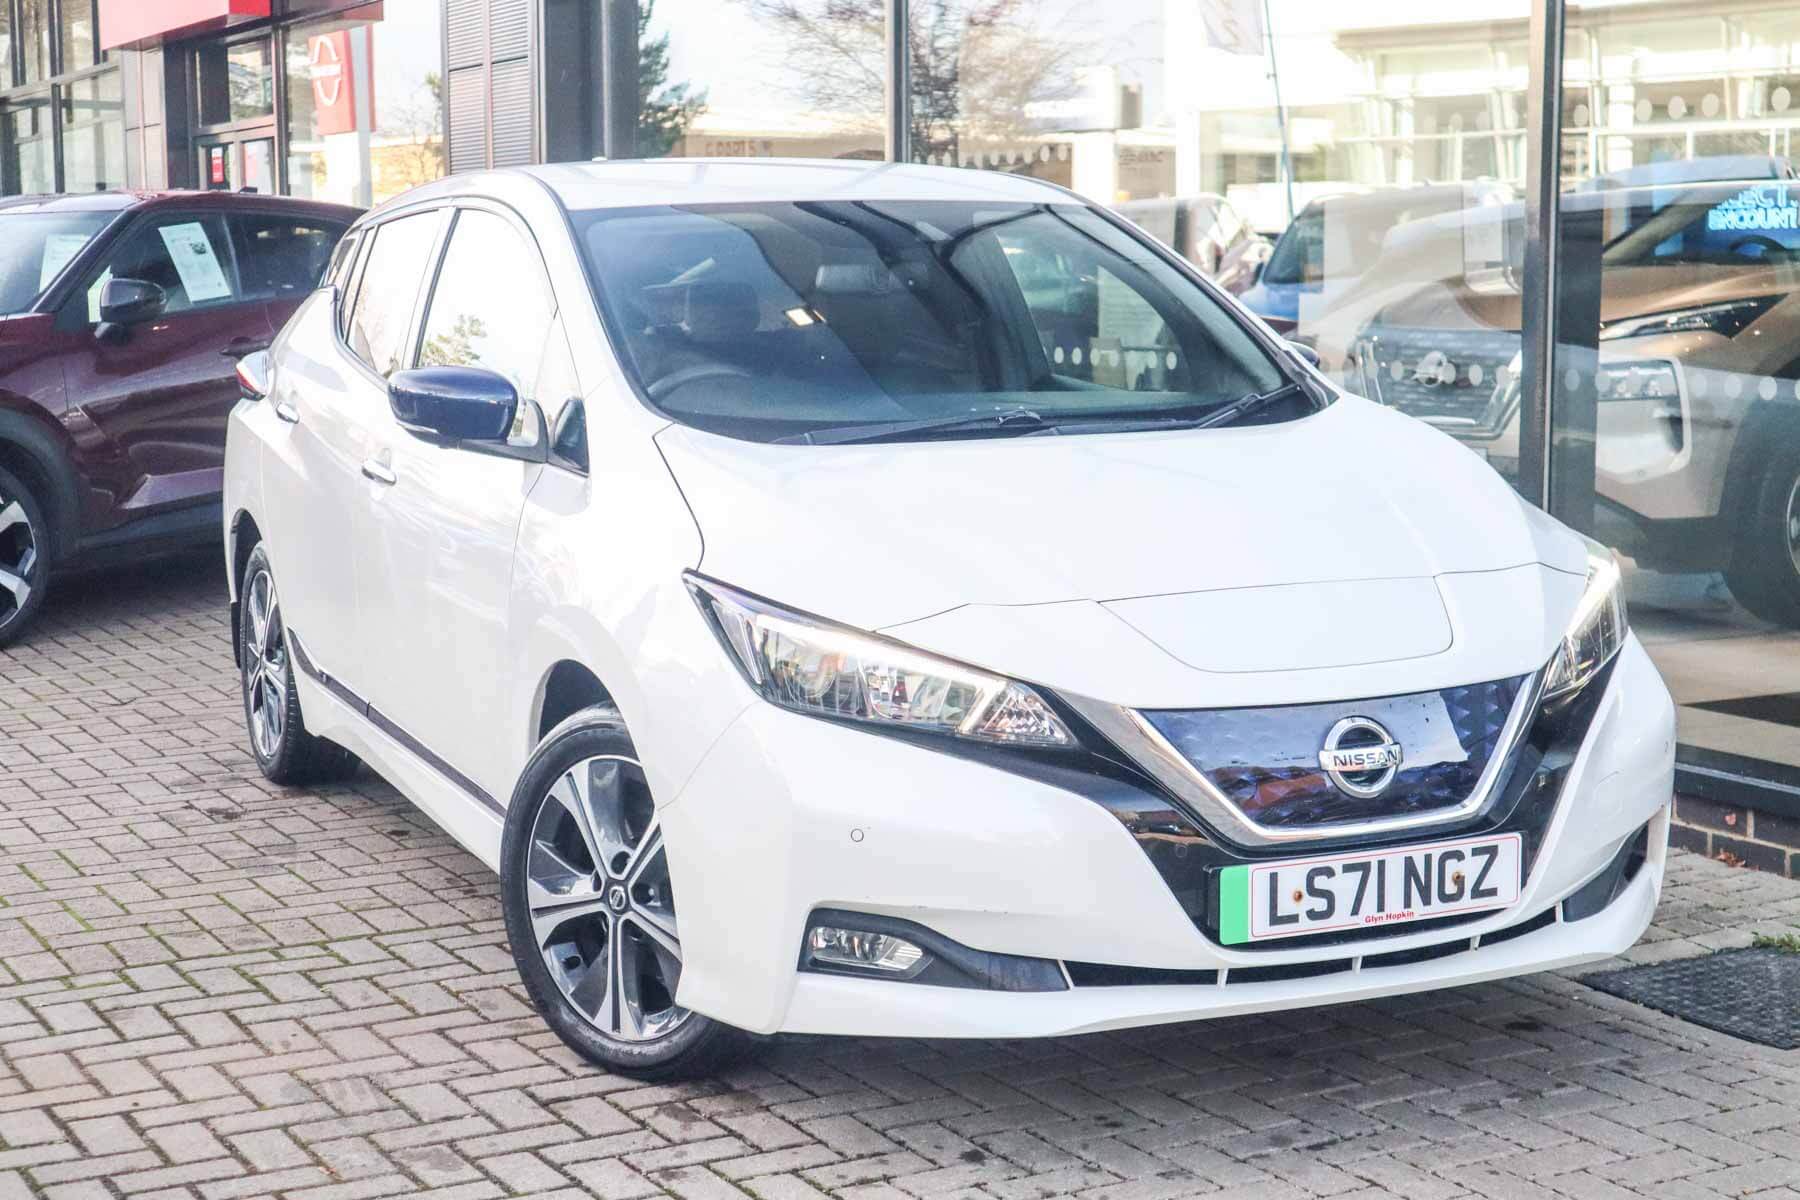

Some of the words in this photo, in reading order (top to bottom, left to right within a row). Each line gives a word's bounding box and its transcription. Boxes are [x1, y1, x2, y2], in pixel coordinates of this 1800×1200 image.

[1333, 749, 1398, 767] NISSAN
[1269, 859, 1385, 926] LS71
[1403, 844, 1499, 909] NGZ
[1365, 914, 1384, 923] Glyn
[1386, 911, 1415, 920] Hopkin
